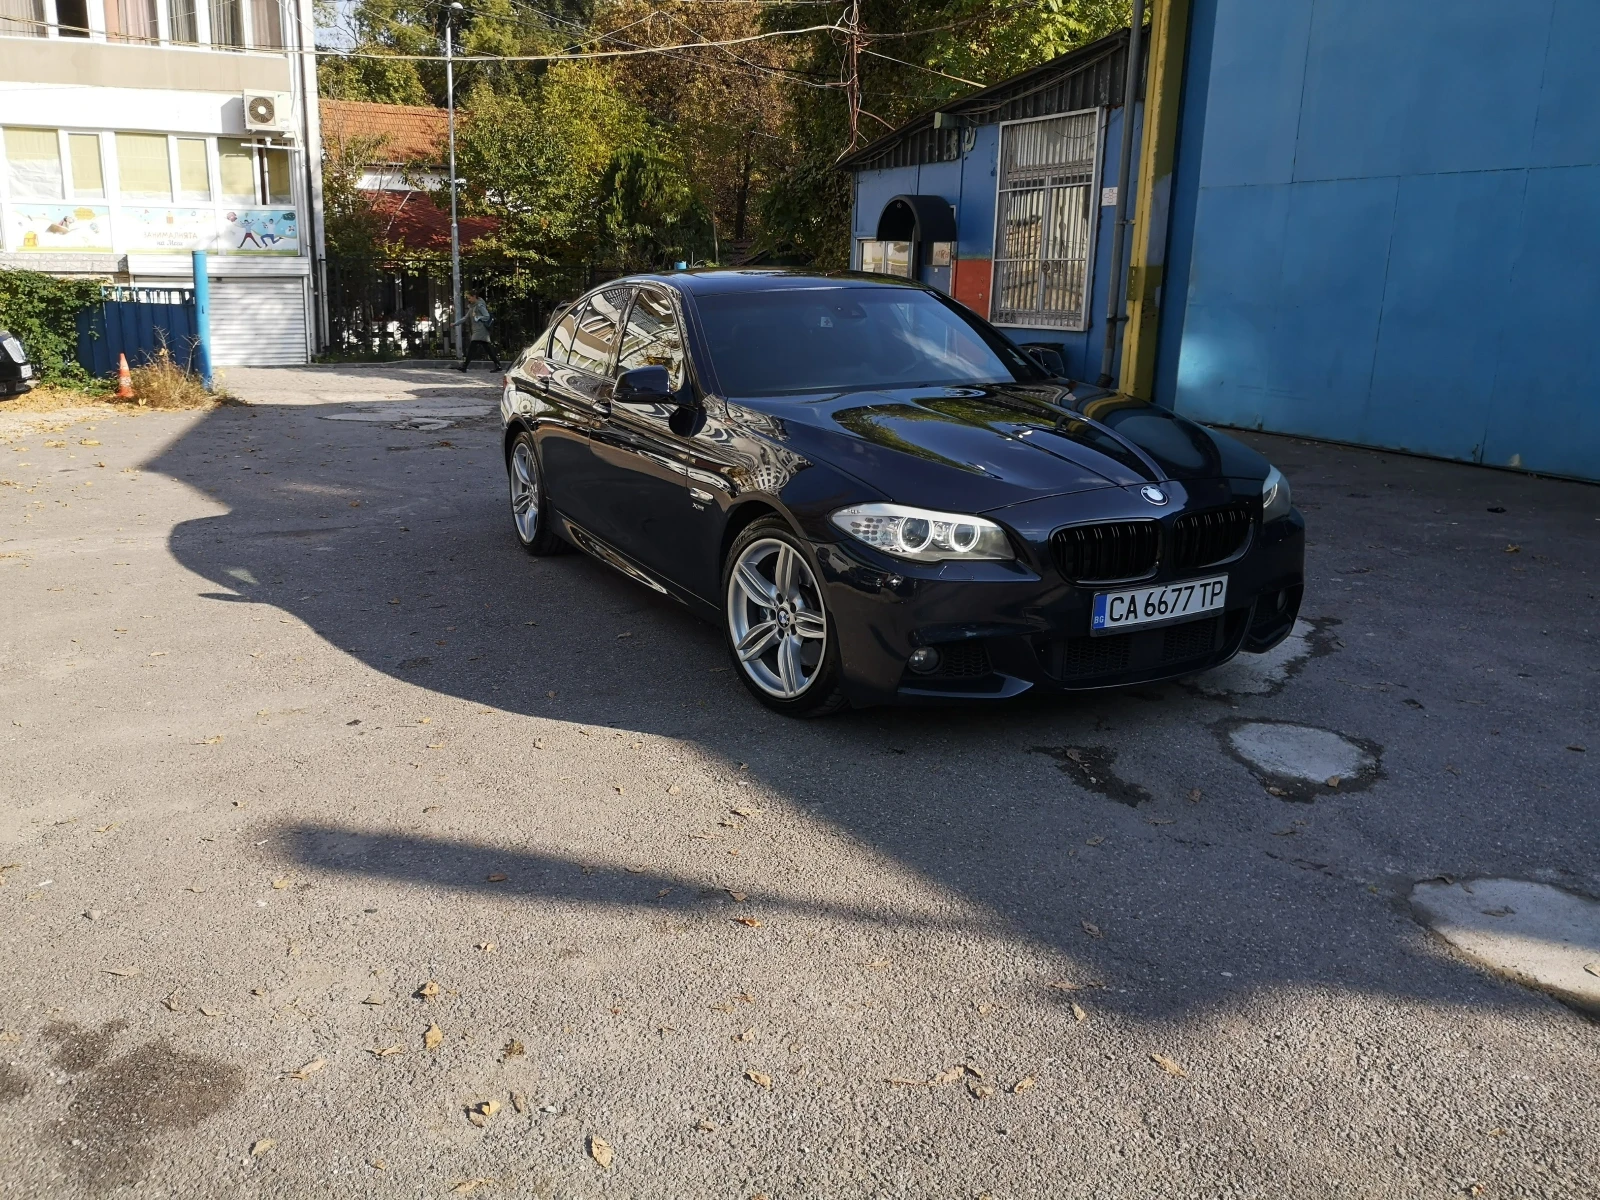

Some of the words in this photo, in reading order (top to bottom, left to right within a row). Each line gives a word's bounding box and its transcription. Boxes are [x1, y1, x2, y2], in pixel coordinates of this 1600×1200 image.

[144, 231, 198, 239] ЗАНИМАЛНЯТА
[1109, 594, 1138, 622] CA
[1144, 584, 1196, 617] 6677
[1199, 580, 1224, 608] TP
[1094, 615, 1104, 624] BG
